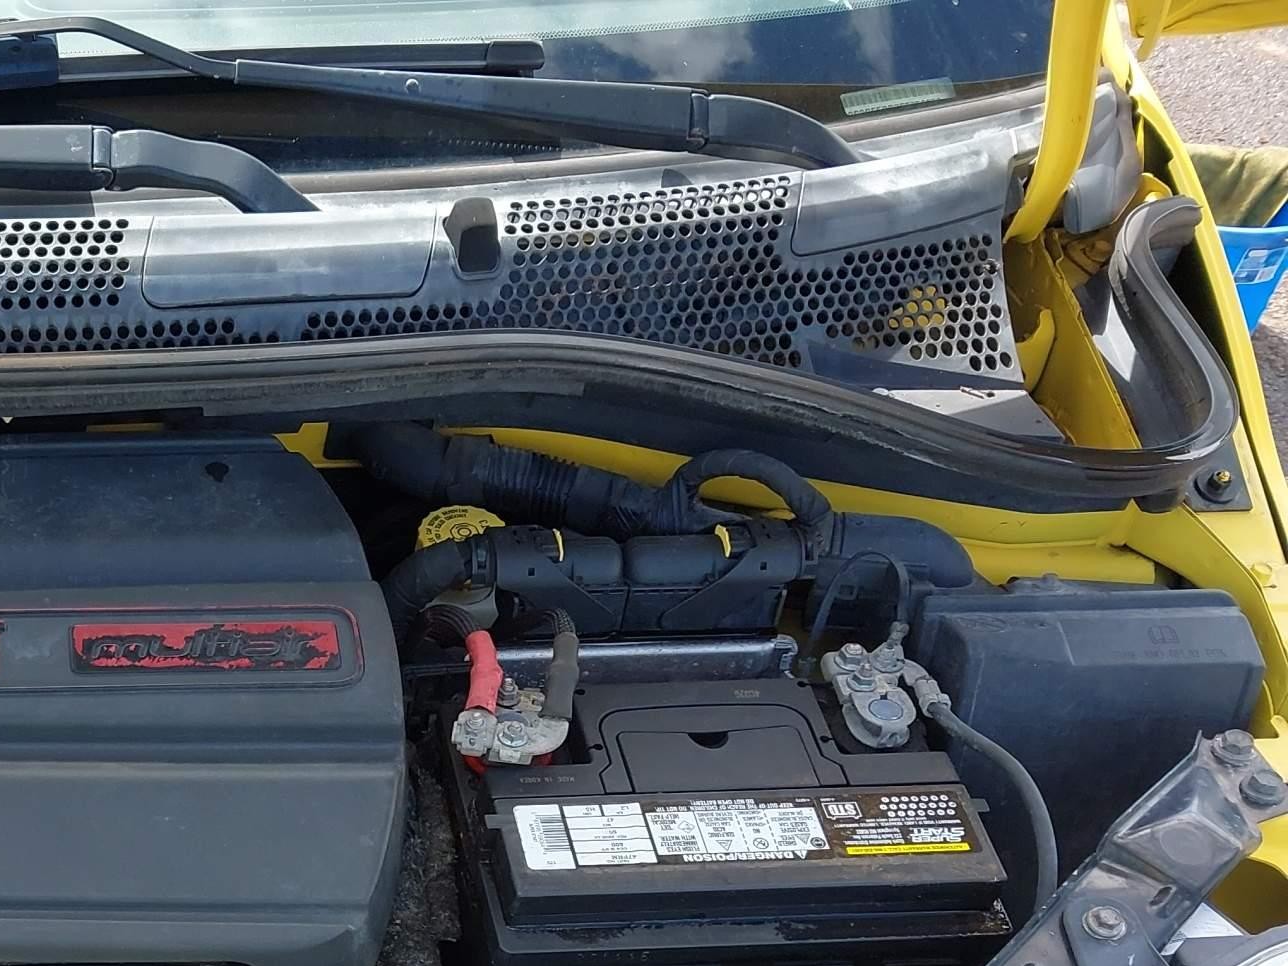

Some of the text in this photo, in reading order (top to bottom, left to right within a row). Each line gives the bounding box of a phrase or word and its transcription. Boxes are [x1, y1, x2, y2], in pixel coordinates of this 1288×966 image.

[828, 804, 857, 816] STD
[911, 827, 965, 835] START
[682, 851, 794, 862] DANGER/POISON
